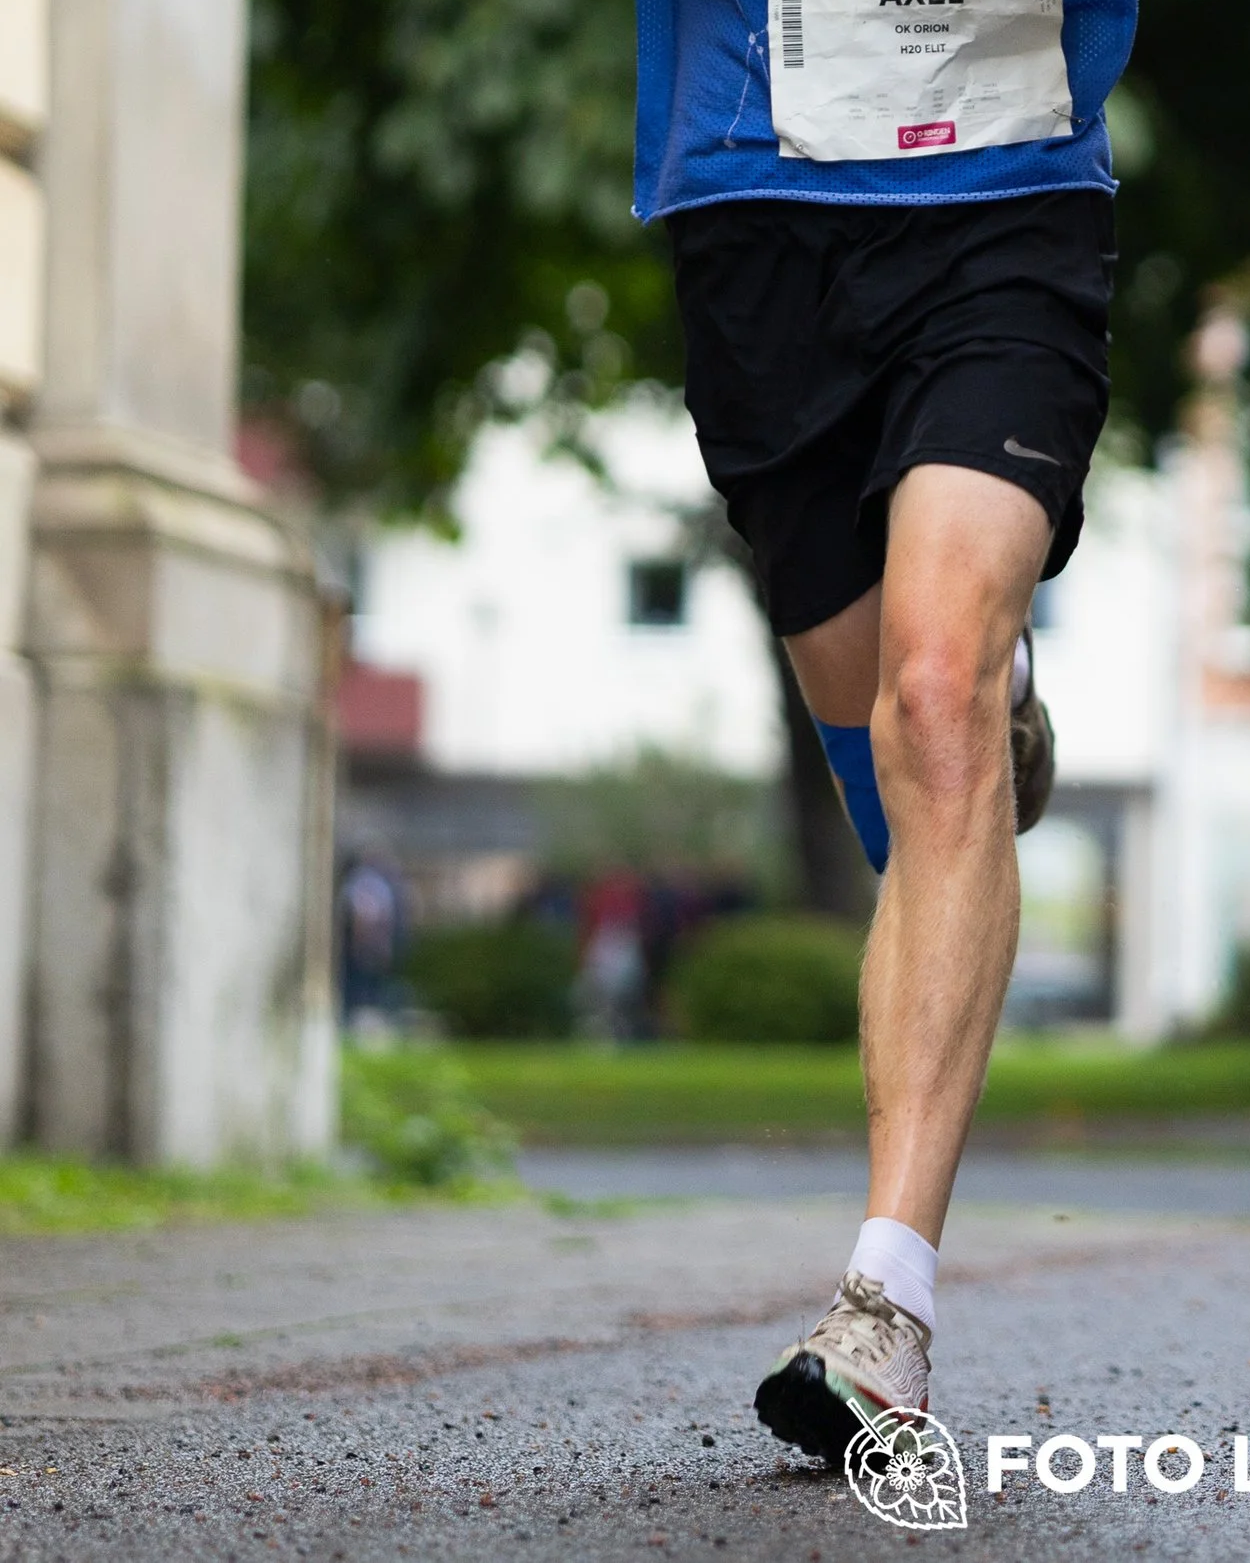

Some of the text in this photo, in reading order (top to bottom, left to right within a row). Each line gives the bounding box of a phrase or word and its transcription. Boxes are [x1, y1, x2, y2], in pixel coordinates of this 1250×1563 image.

[895, 24, 950, 33] OK ORION
[900, 43, 946, 54] H20 ELIT
